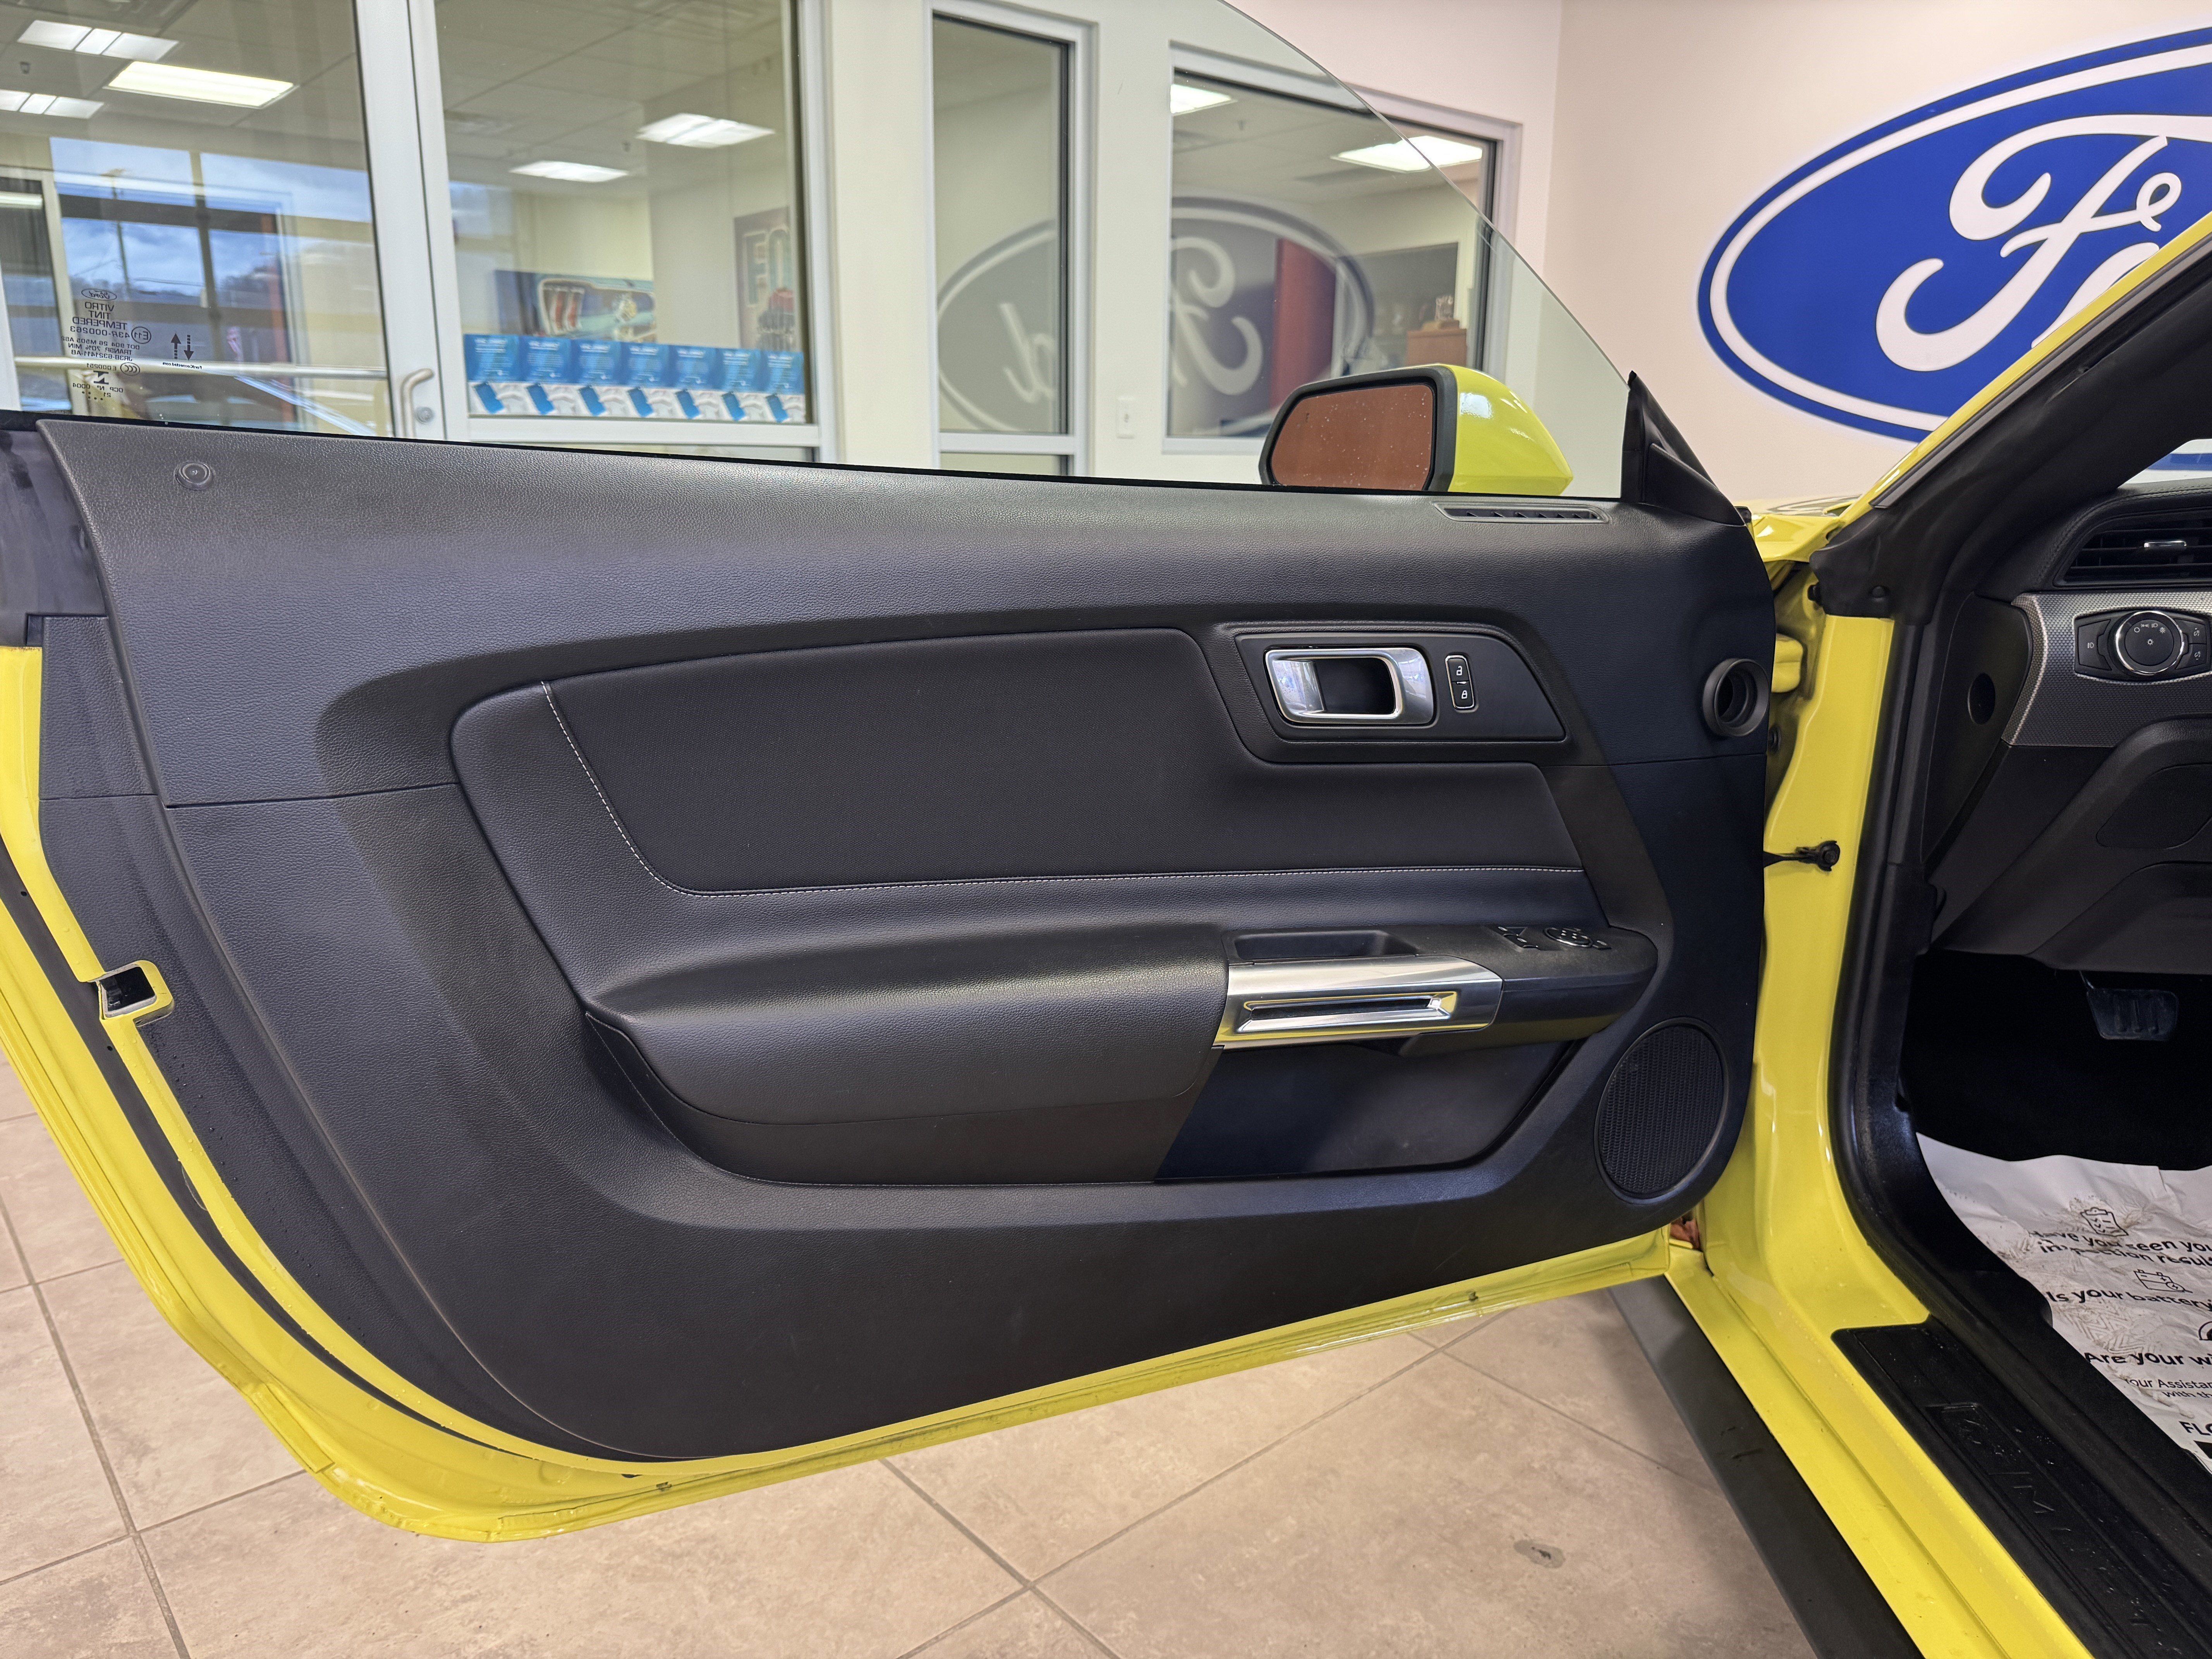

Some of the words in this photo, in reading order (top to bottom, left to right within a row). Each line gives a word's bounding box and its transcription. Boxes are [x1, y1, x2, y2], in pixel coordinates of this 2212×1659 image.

[2047, 1291, 2069, 1302] Is
[2071, 1289, 2123, 1304] your
[2084, 1352, 2127, 1363] Are
[2129, 1353, 2184, 1365] your
